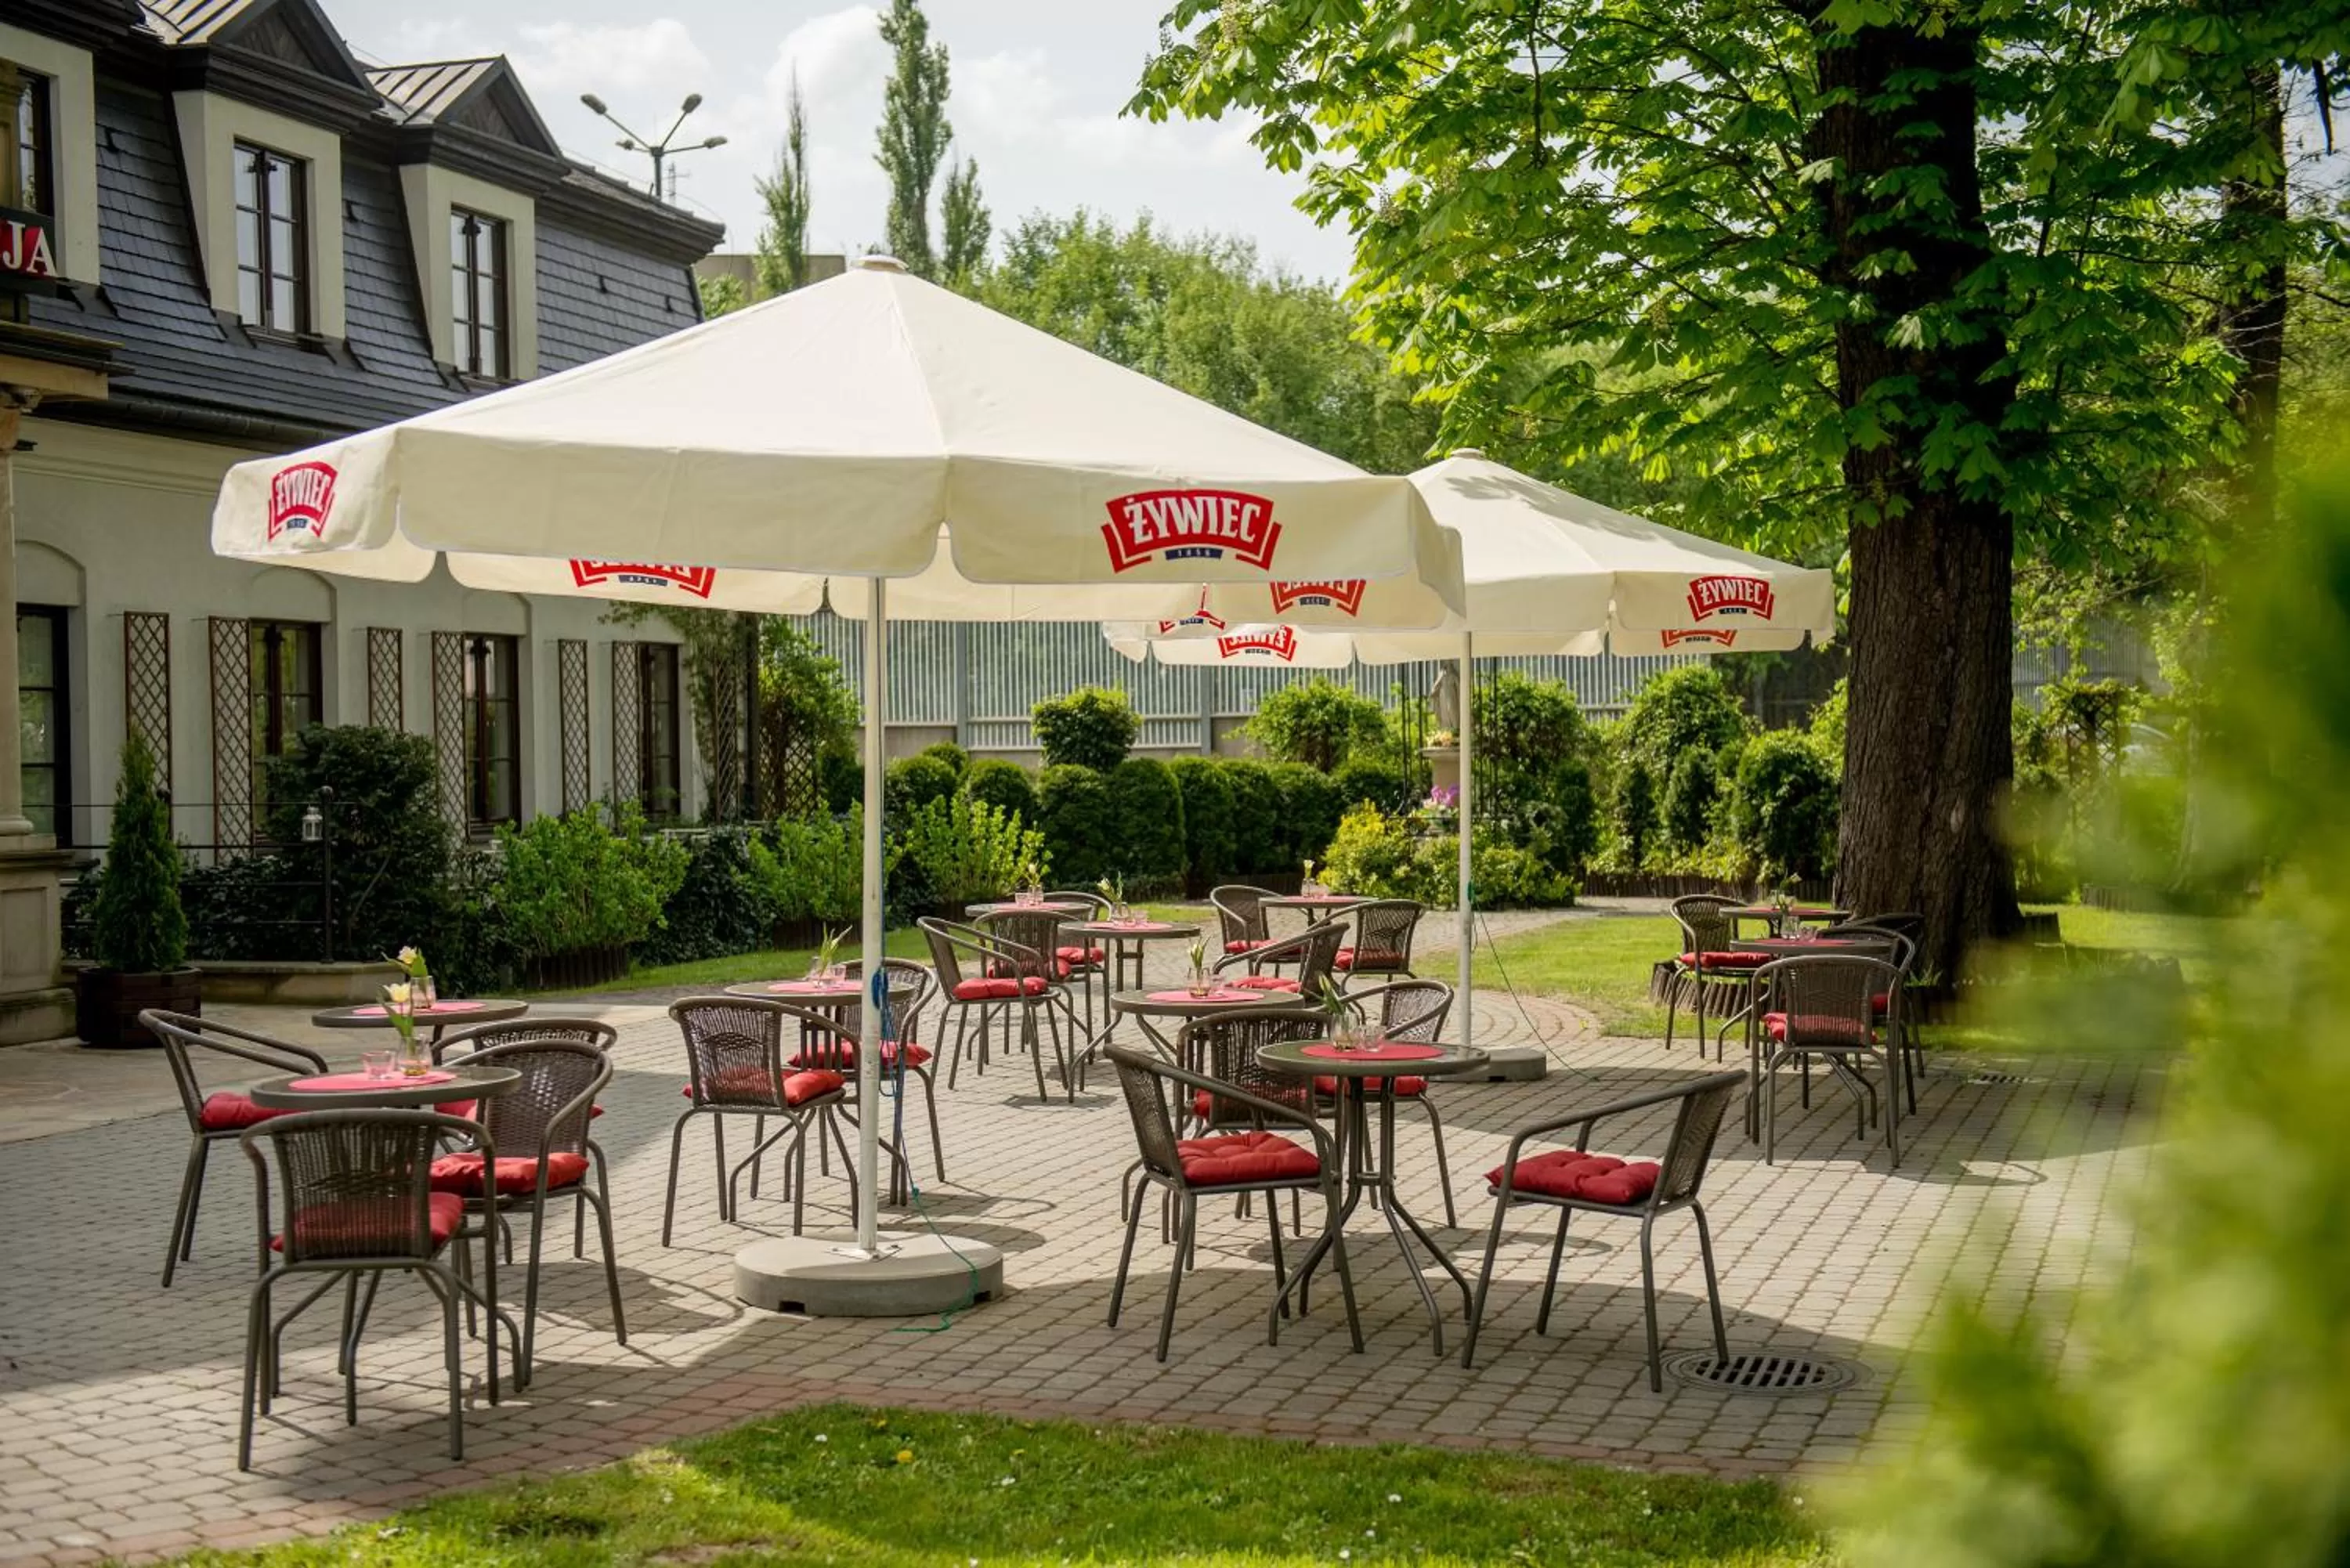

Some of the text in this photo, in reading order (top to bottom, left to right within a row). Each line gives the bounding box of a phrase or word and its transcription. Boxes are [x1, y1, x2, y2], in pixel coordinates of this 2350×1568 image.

[276, 468, 331, 516] ŻYWIEC
[1123, 496, 1261, 544] ŻYWIEC
[1697, 578, 1764, 606] ŻYWIEC
